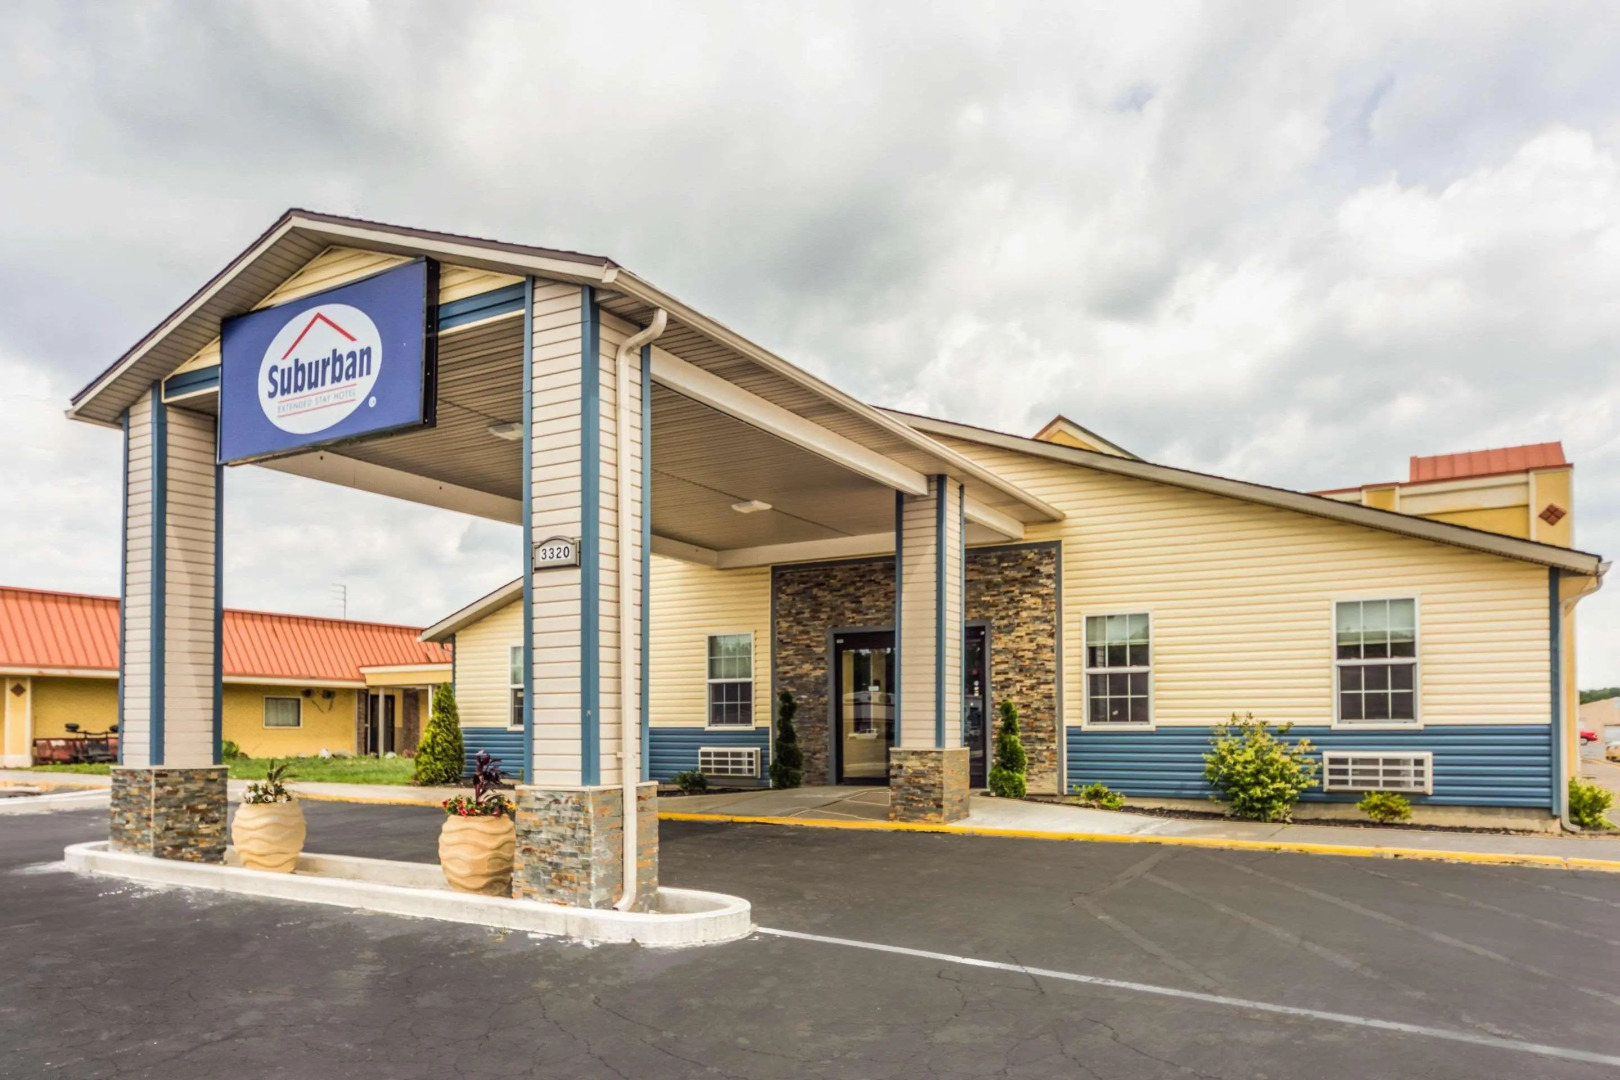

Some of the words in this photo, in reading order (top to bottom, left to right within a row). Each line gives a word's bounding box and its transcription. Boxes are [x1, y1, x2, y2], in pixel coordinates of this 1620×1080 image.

[268, 346, 372, 399] Suburban
[277, 400, 313, 414] EXTENDED
[315, 394, 331, 405] STAY
[333, 388, 356, 400] HOTEL
[541, 546, 570, 560] 3320
